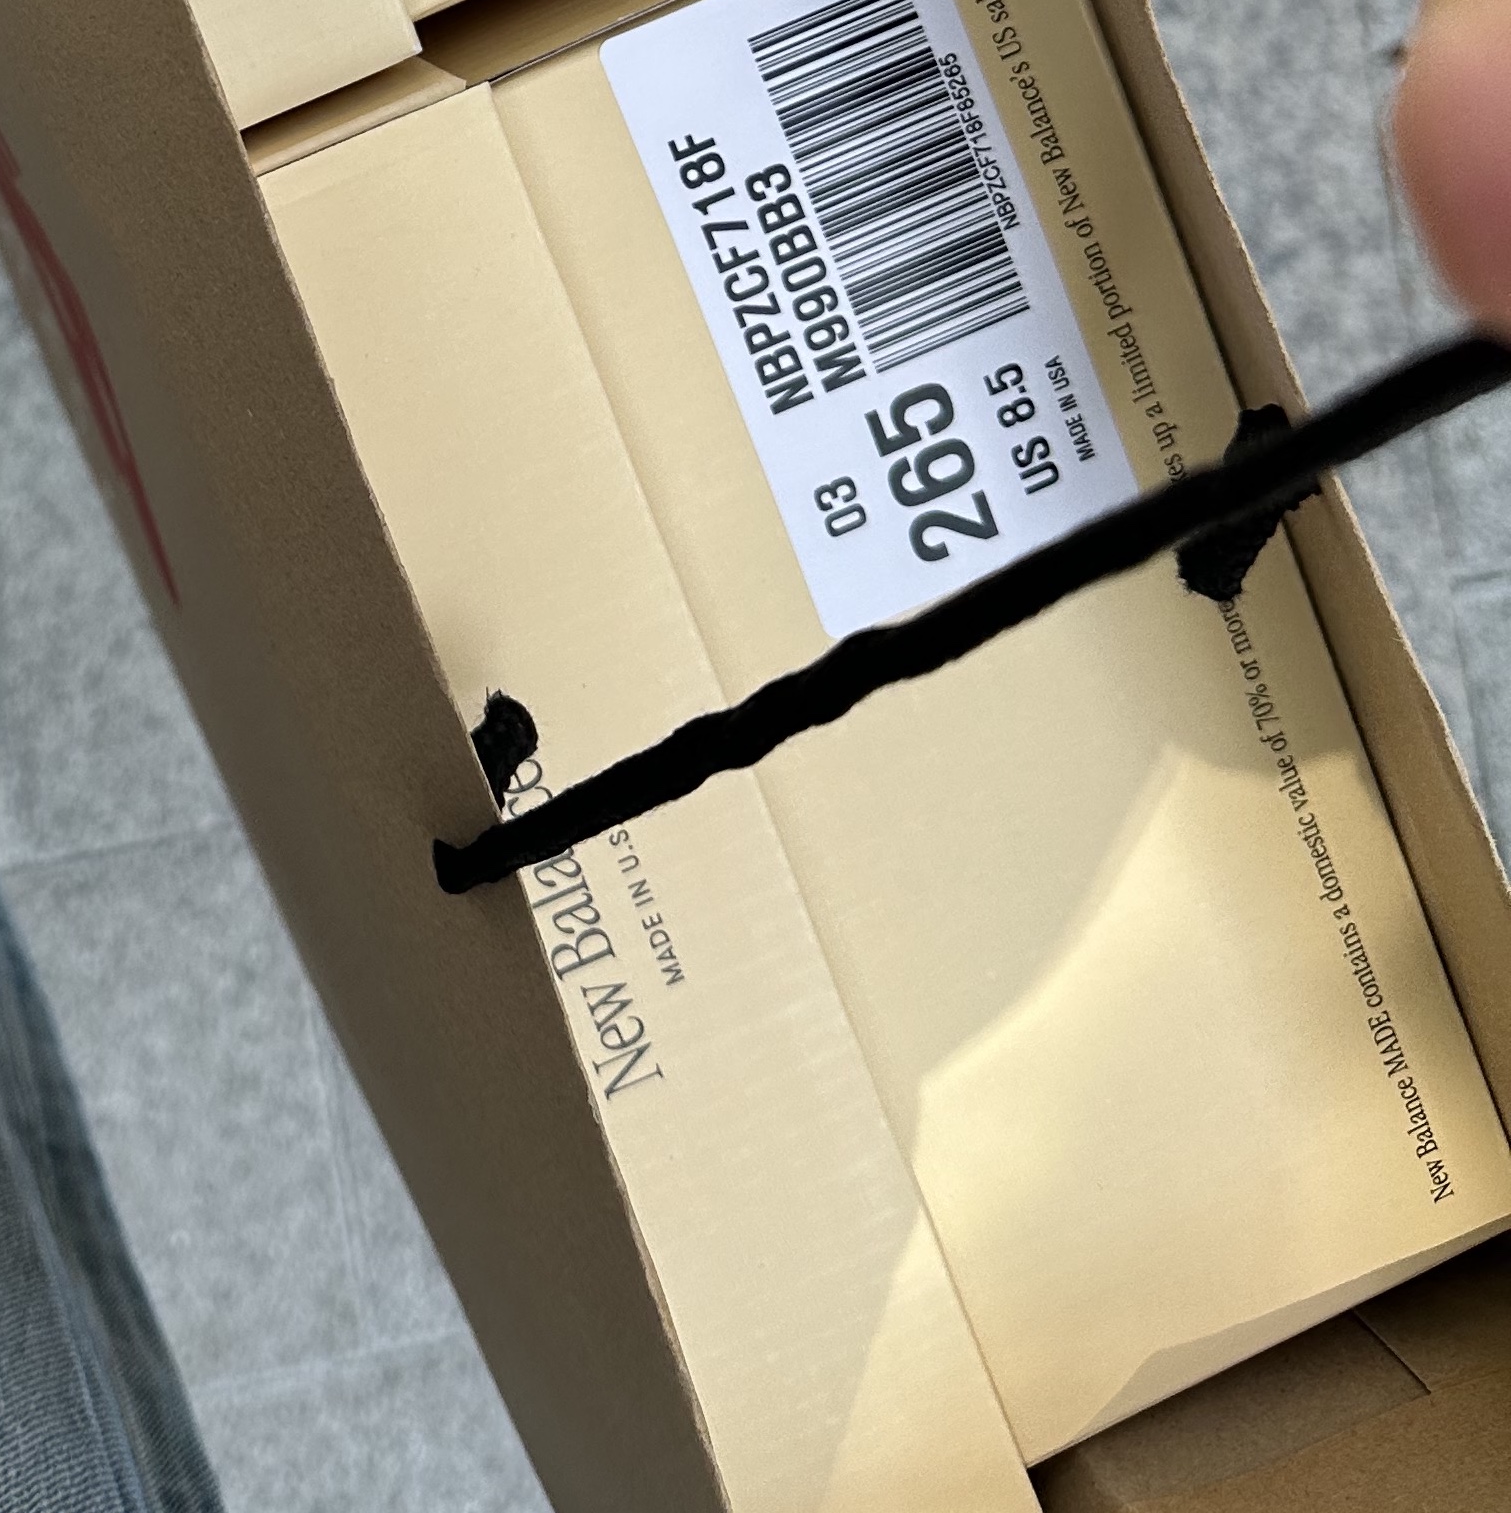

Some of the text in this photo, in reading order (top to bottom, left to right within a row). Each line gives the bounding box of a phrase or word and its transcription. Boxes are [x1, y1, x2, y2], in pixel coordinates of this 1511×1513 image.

[992, 26, 1023, 62] US
[938, 52, 1021, 231] NBPZCF718F85265
[1052, 167, 1086, 216] New
[1064, 215, 1094, 239] of
[667, 134, 815, 416] NBPZCF718F
[744, 163, 867, 394] M990BB3
[1083, 241, 1134, 320] portion
[1106, 321, 1157, 404] limited
[983, 363, 1060, 495] US 8.5
[1044, 354, 1096, 462] MADE IN USA
[1145, 400, 1164, 418] a
[1152, 421, 1179, 452] up
[813, 476, 867, 538] 03
[864, 383, 1000, 563] 265
[1218, 597, 1253, 656] more
[1239, 659, 1262, 681] or
[1245, 683, 1280, 731] 70%
[1259, 730, 1288, 754] of
[1276, 754, 1309, 812] value
[1297, 812, 1344, 902] domestic
[608, 828, 685, 986] MADE IN U.S
[1332, 903, 1351, 920] a
[1339, 922, 1384, 1008] contains
[580, 982, 665, 1100] New
[1367, 1009, 1409, 1078] MADE
[1397, 1076, 1439, 1159] Balance
[1426, 1159, 1455, 1204] New
